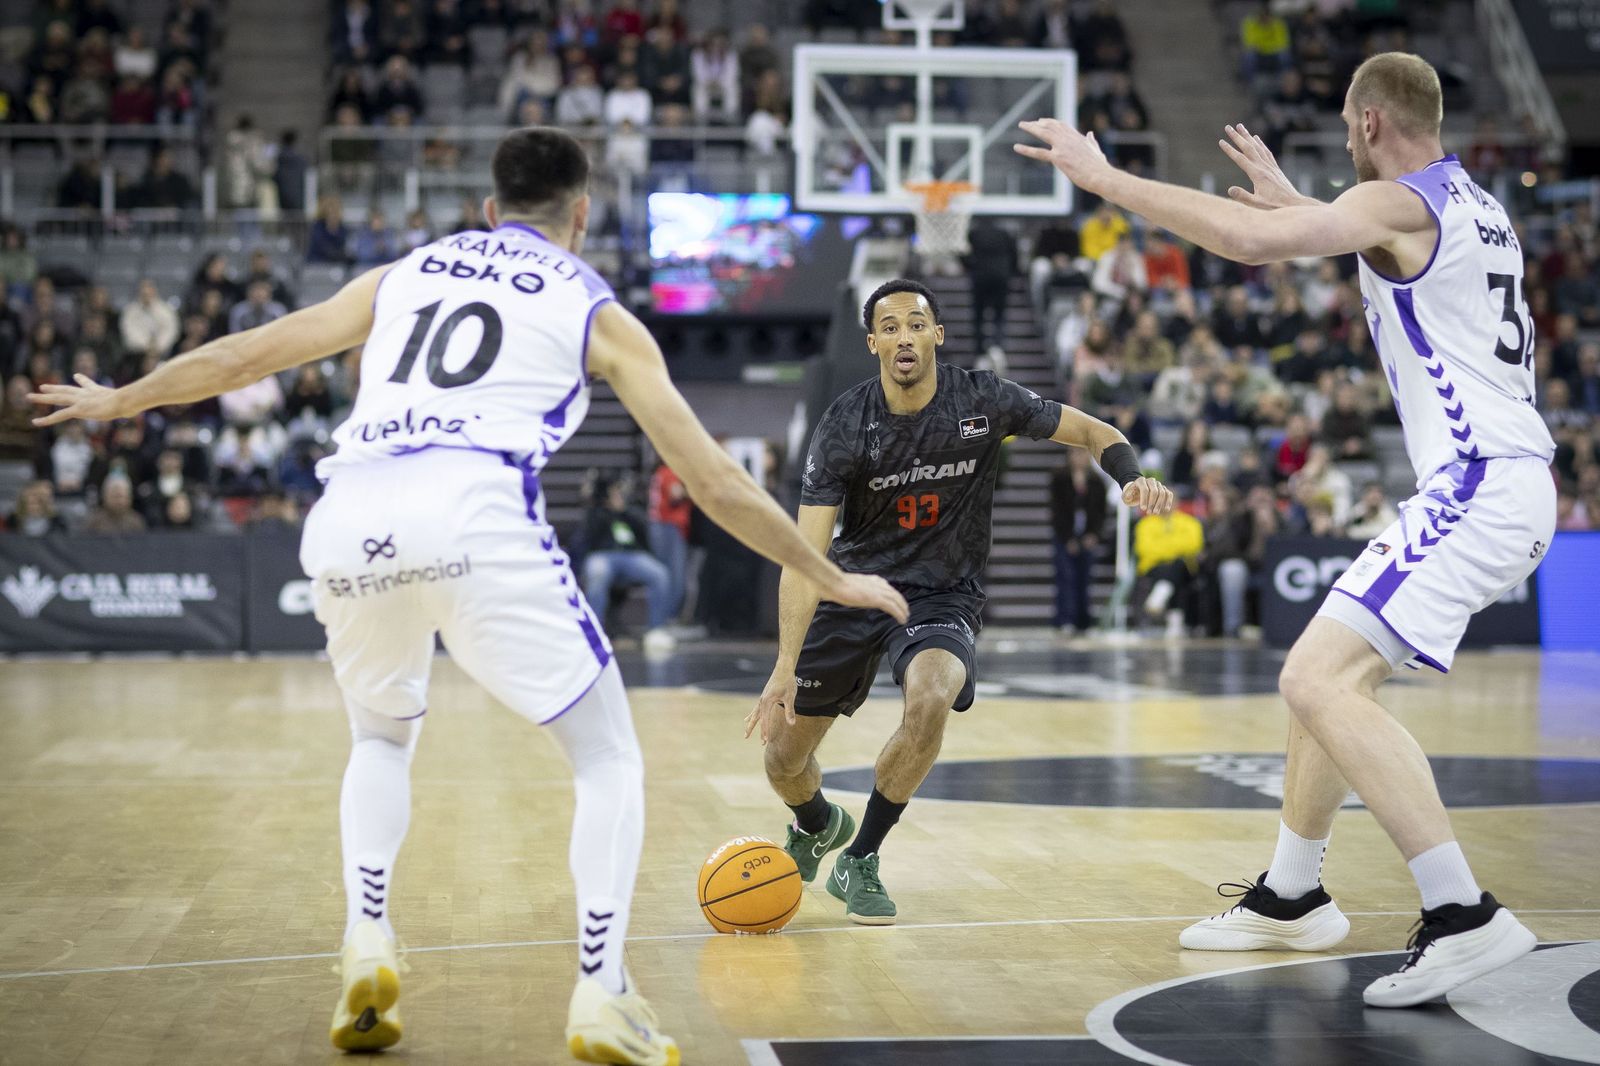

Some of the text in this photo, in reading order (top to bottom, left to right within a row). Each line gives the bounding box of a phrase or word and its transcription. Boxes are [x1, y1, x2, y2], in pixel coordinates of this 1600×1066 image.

[420, 255, 500, 283] bbk
[438, 236, 581, 281] RAMPELJ
[387, 299, 503, 389] 10
[896, 494, 940, 530] 93
[357, 553, 472, 597] Financial
[743, 855, 771, 870] acb
